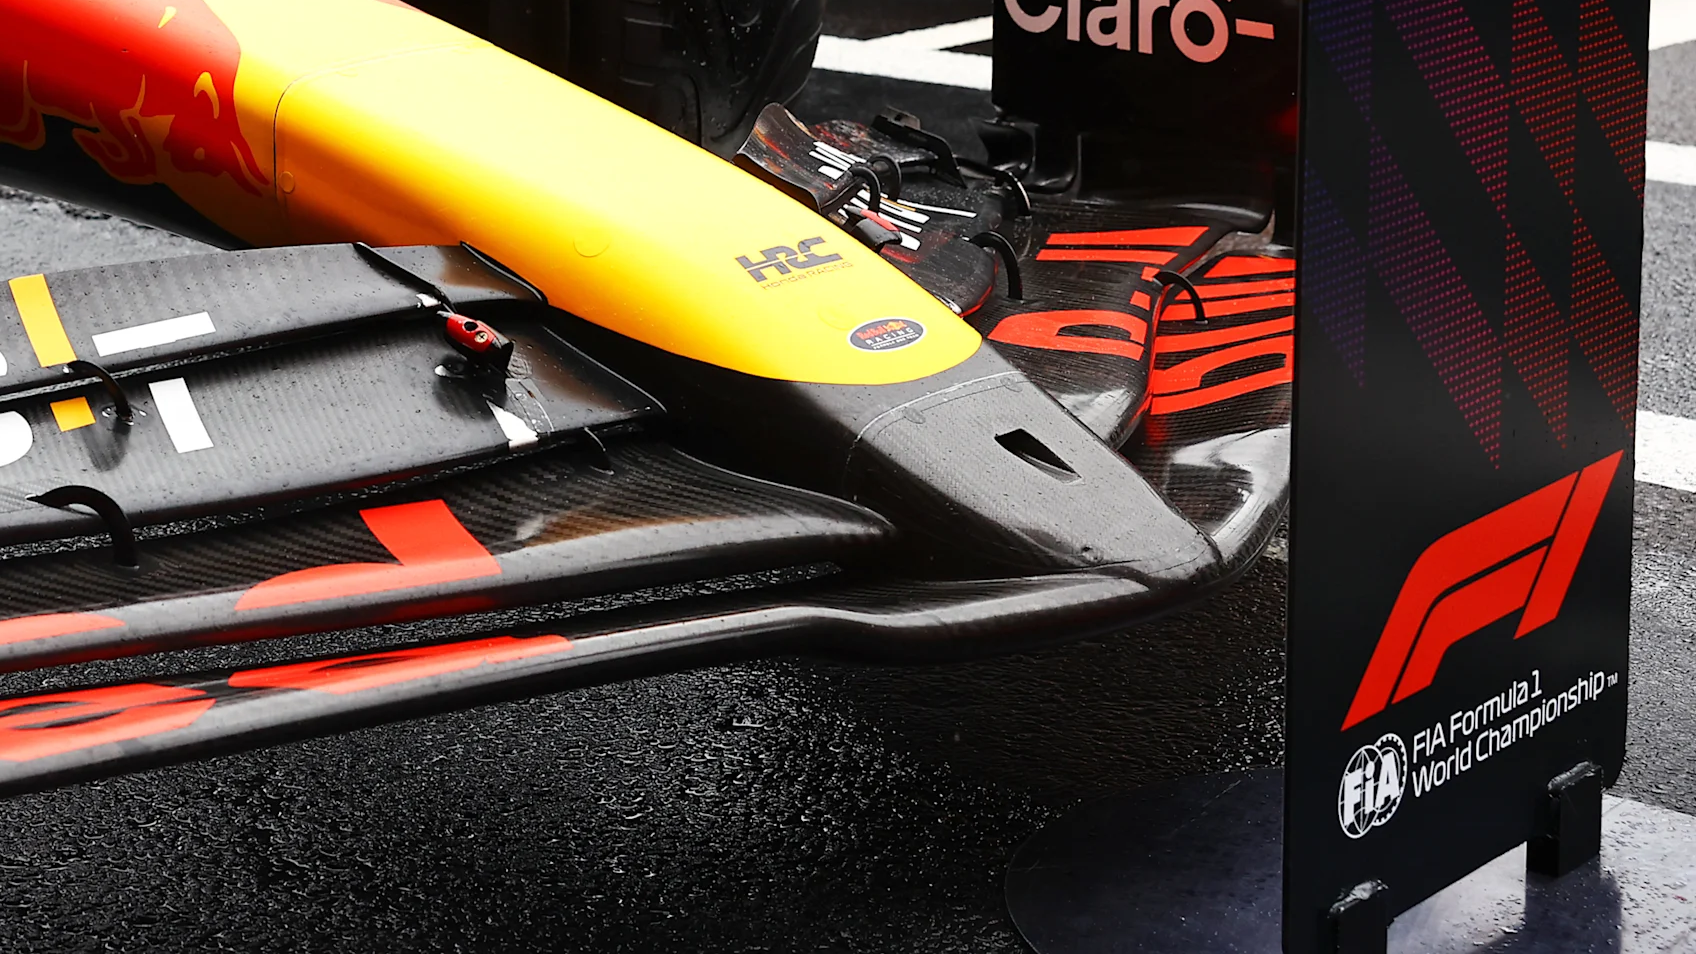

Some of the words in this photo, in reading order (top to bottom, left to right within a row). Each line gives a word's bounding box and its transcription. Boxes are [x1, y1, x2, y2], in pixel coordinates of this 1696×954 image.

[735, 236, 844, 283] HRC
[865, 327, 914, 345] RACING
[1411, 741, 1472, 797] World
[1475, 671, 1605, 762] Championship
[1412, 723, 1447, 764] FIA
[1449, 679, 1530, 744] Formula
[1530, 669, 1543, 698] 1
